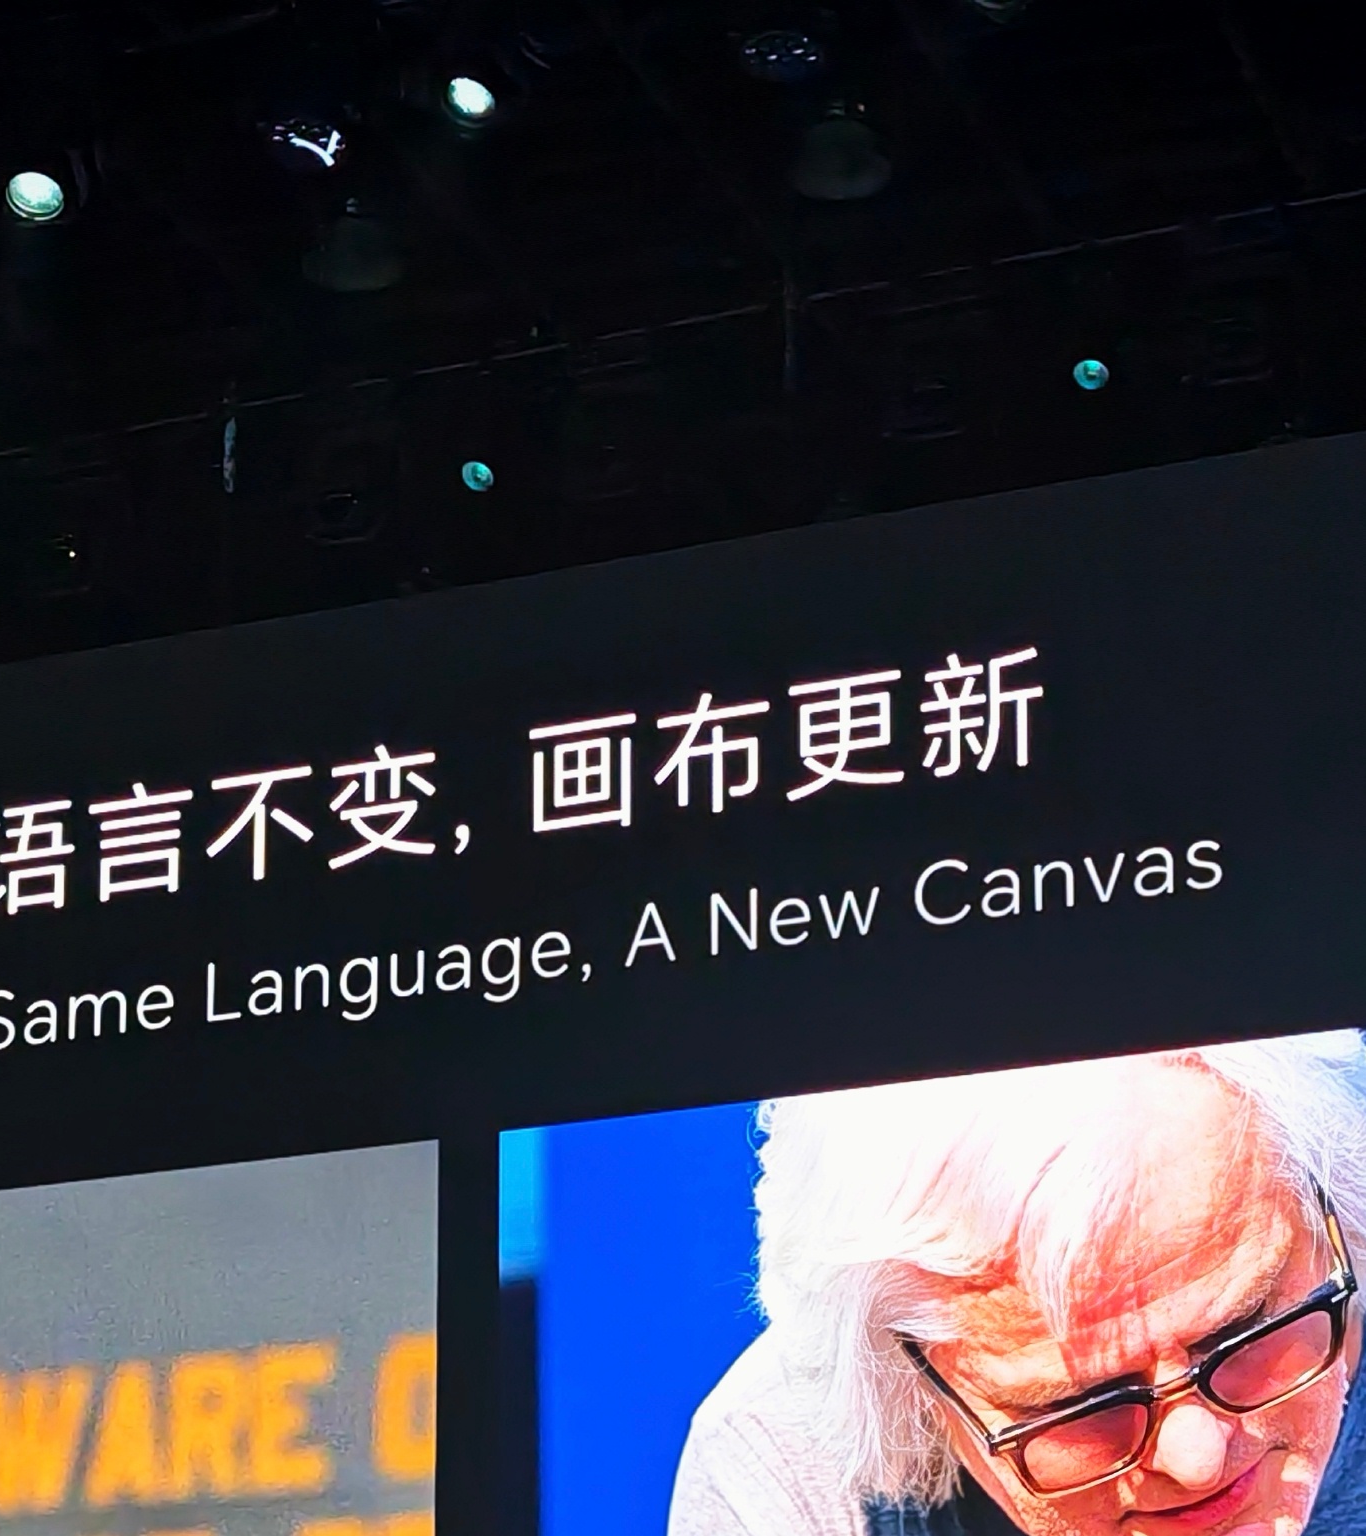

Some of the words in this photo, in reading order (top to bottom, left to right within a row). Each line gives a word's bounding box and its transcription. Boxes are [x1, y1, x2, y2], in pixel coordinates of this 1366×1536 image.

[206, 931, 592, 1023] Language,
[624, 901, 677, 968] A
[710, 886, 880, 956] New
[914, 839, 1223, 925] Canvas
